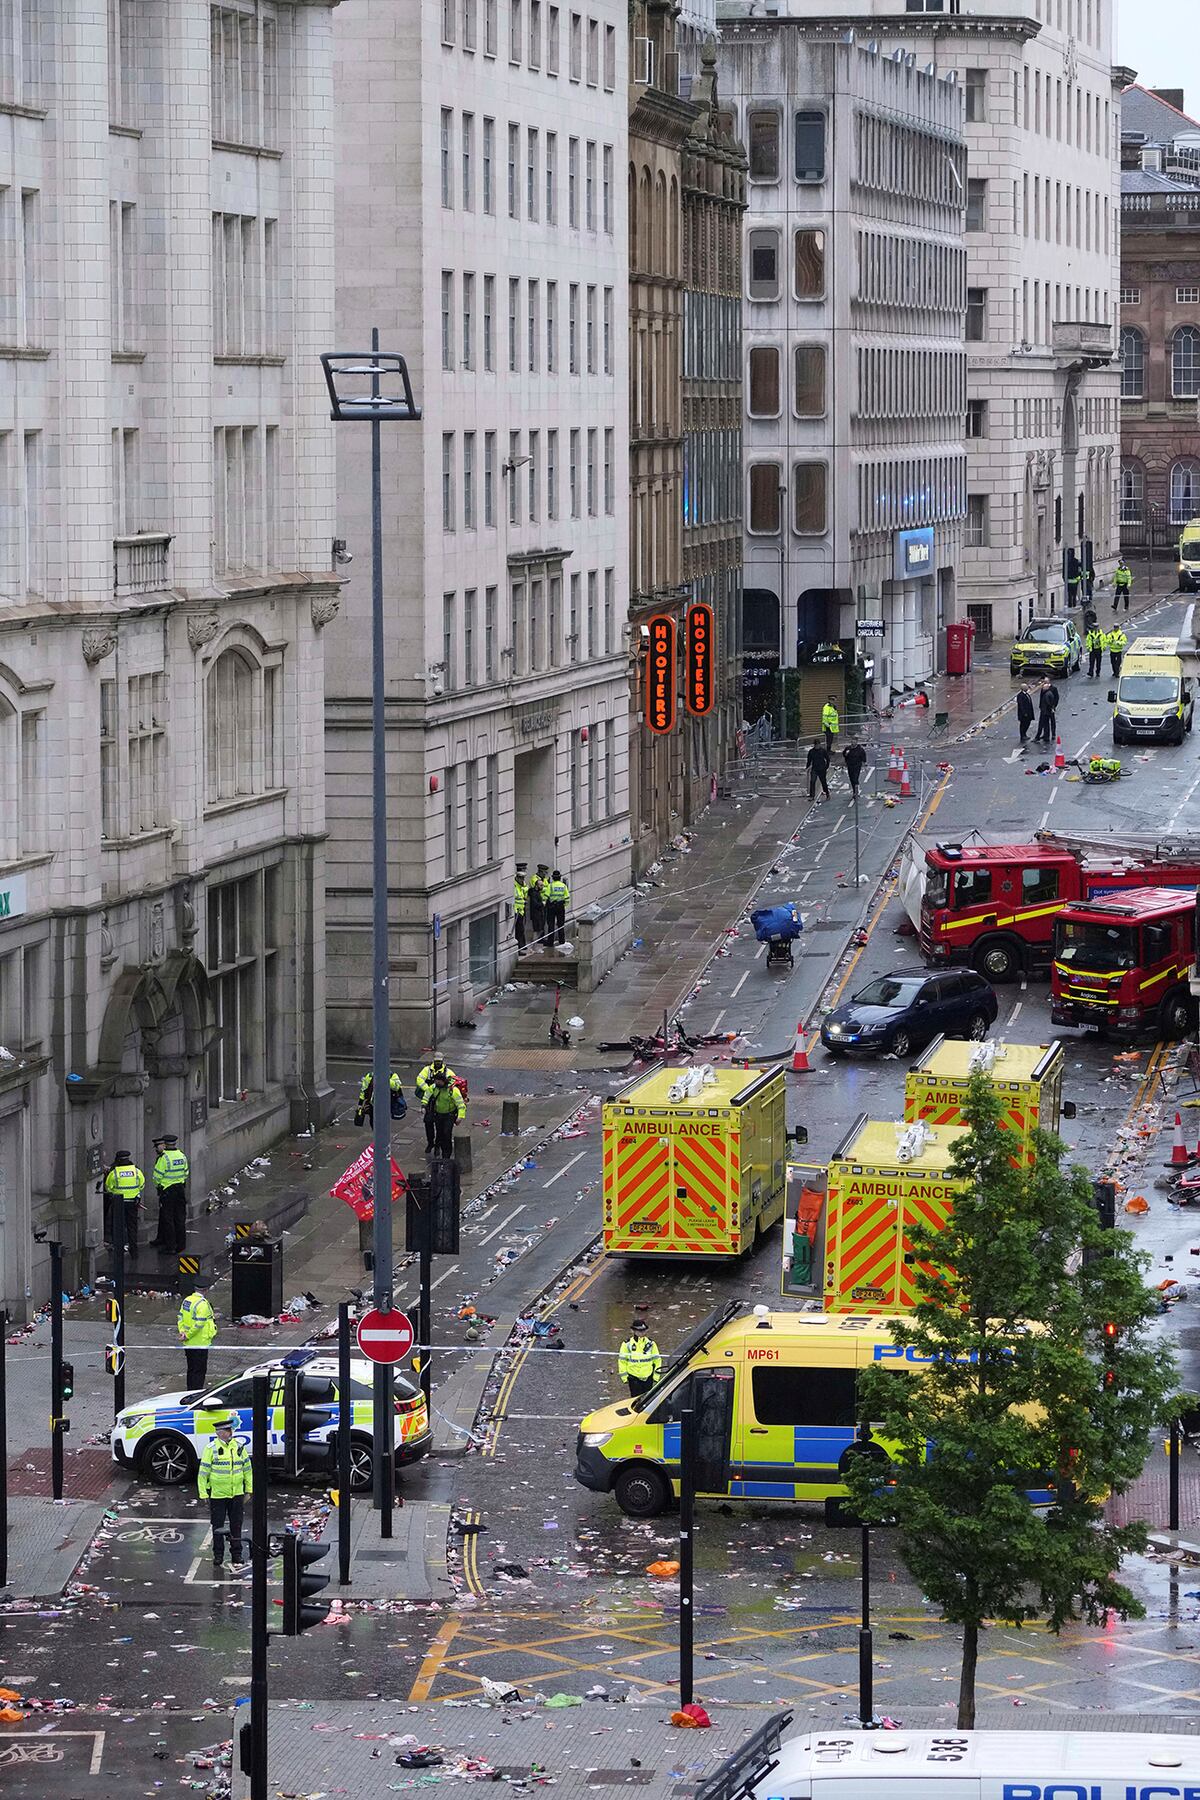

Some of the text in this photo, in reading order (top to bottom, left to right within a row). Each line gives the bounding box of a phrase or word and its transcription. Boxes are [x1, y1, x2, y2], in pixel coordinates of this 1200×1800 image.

[694, 613, 705, 709] HOOTERS
[655, 625, 667, 727] HOOTERS
[623, 1122, 721, 1136] AMBULANCE
[849, 1182, 954, 1199] AMBULANCE
[747, 1349, 779, 1360] MP61
